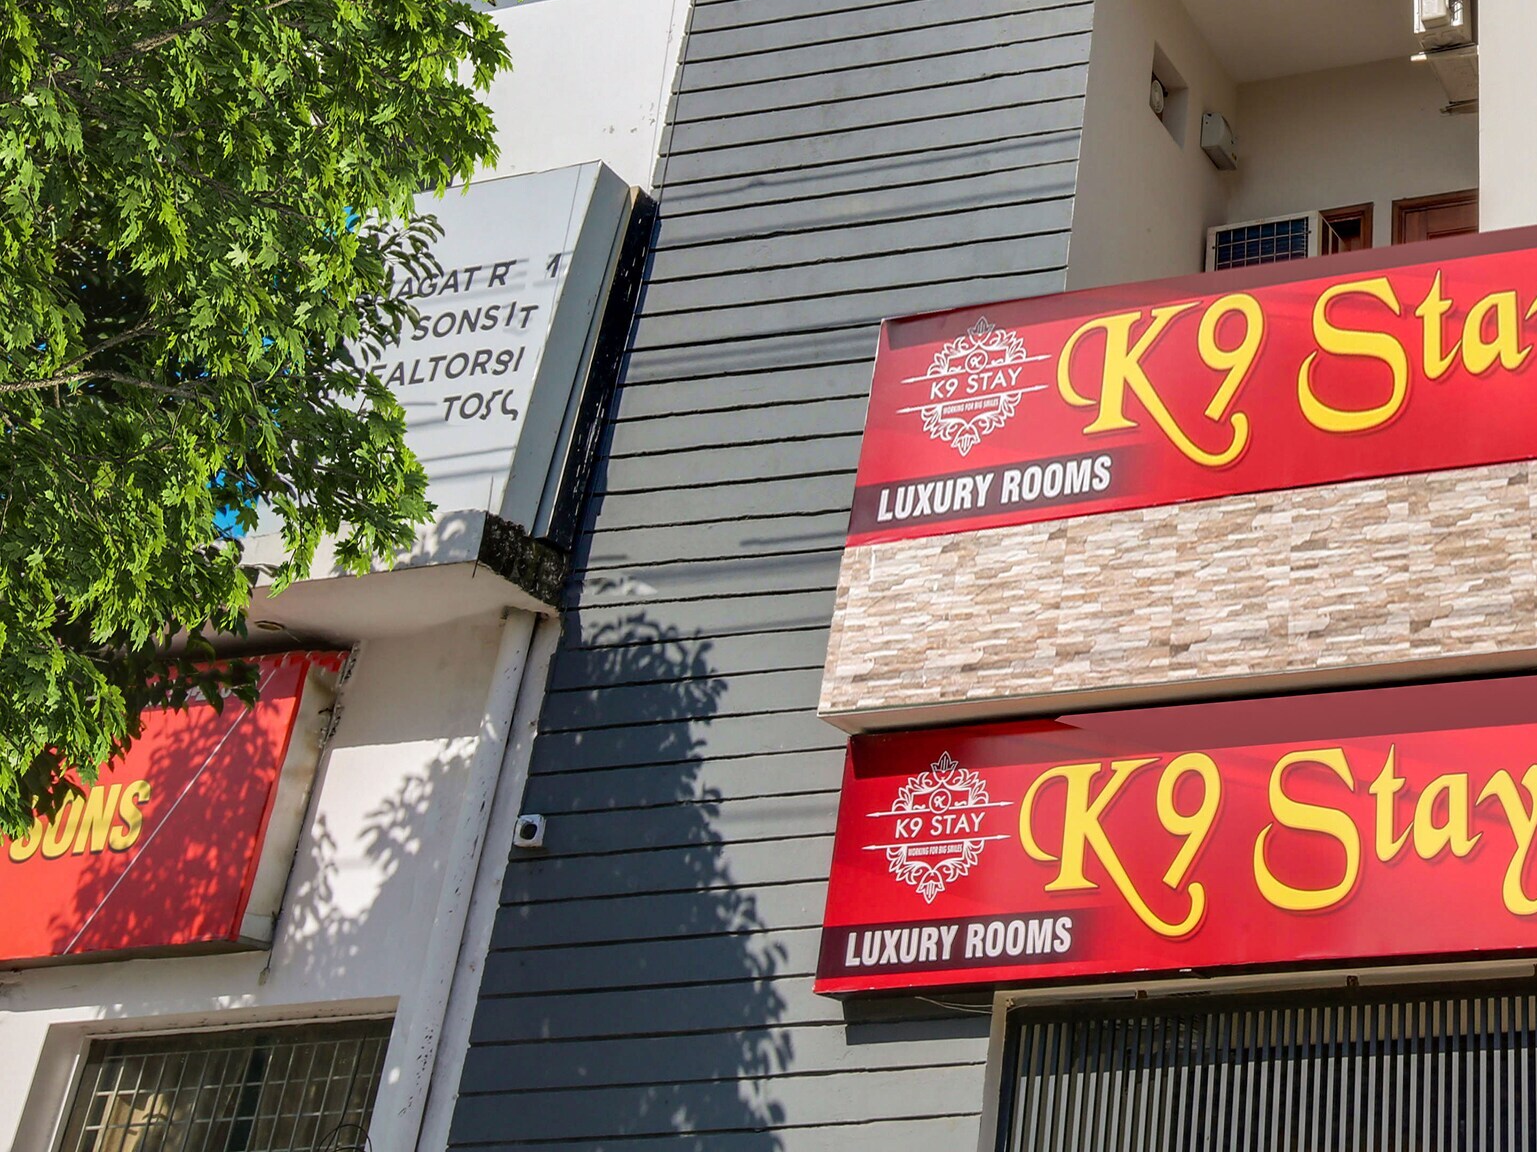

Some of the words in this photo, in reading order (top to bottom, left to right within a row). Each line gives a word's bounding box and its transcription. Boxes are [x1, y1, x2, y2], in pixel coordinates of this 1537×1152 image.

[386, 265, 482, 299] AGAT
[930, 378, 958, 400] K9
[966, 366, 1022, 394] STAY
[1056, 293, 1264, 467] K9
[877, 472, 994, 522] LUXURY
[1000, 455, 1112, 505] ROOMS
[895, 818, 923, 839] K9
[930, 812, 986, 836] STAY
[1019, 752, 1221, 937] K9
[845, 925, 959, 967] LUXURY
[964, 916, 1073, 959] ROOMS
